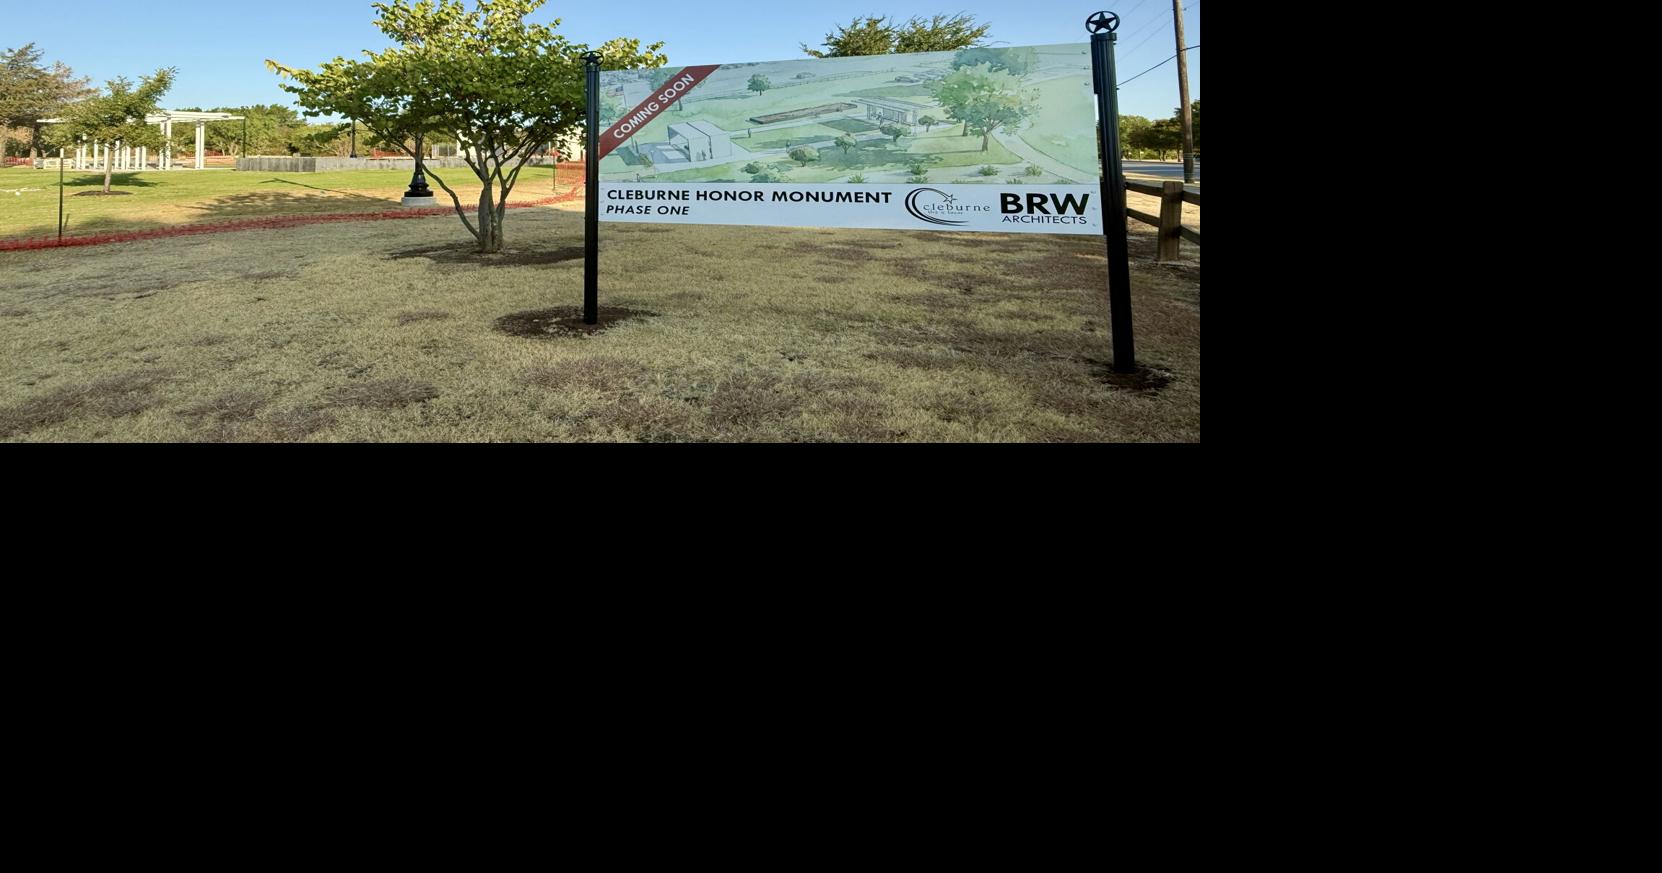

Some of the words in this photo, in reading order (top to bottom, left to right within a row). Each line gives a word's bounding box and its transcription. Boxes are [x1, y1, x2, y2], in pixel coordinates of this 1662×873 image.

[613, 101, 660, 139] COMING
[658, 73, 695, 104] SOON
[607, 189, 690, 201] CLEBURNE
[696, 190, 764, 202] HONOR
[771, 191, 892, 204] MONUMENT
[923, 203, 991, 212] cleburne
[1000, 192, 1089, 215] BRW
[606, 205, 651, 215] PHASE
[657, 205, 690, 216] ONE
[1001, 215, 1087, 225] ARCHITECTS
